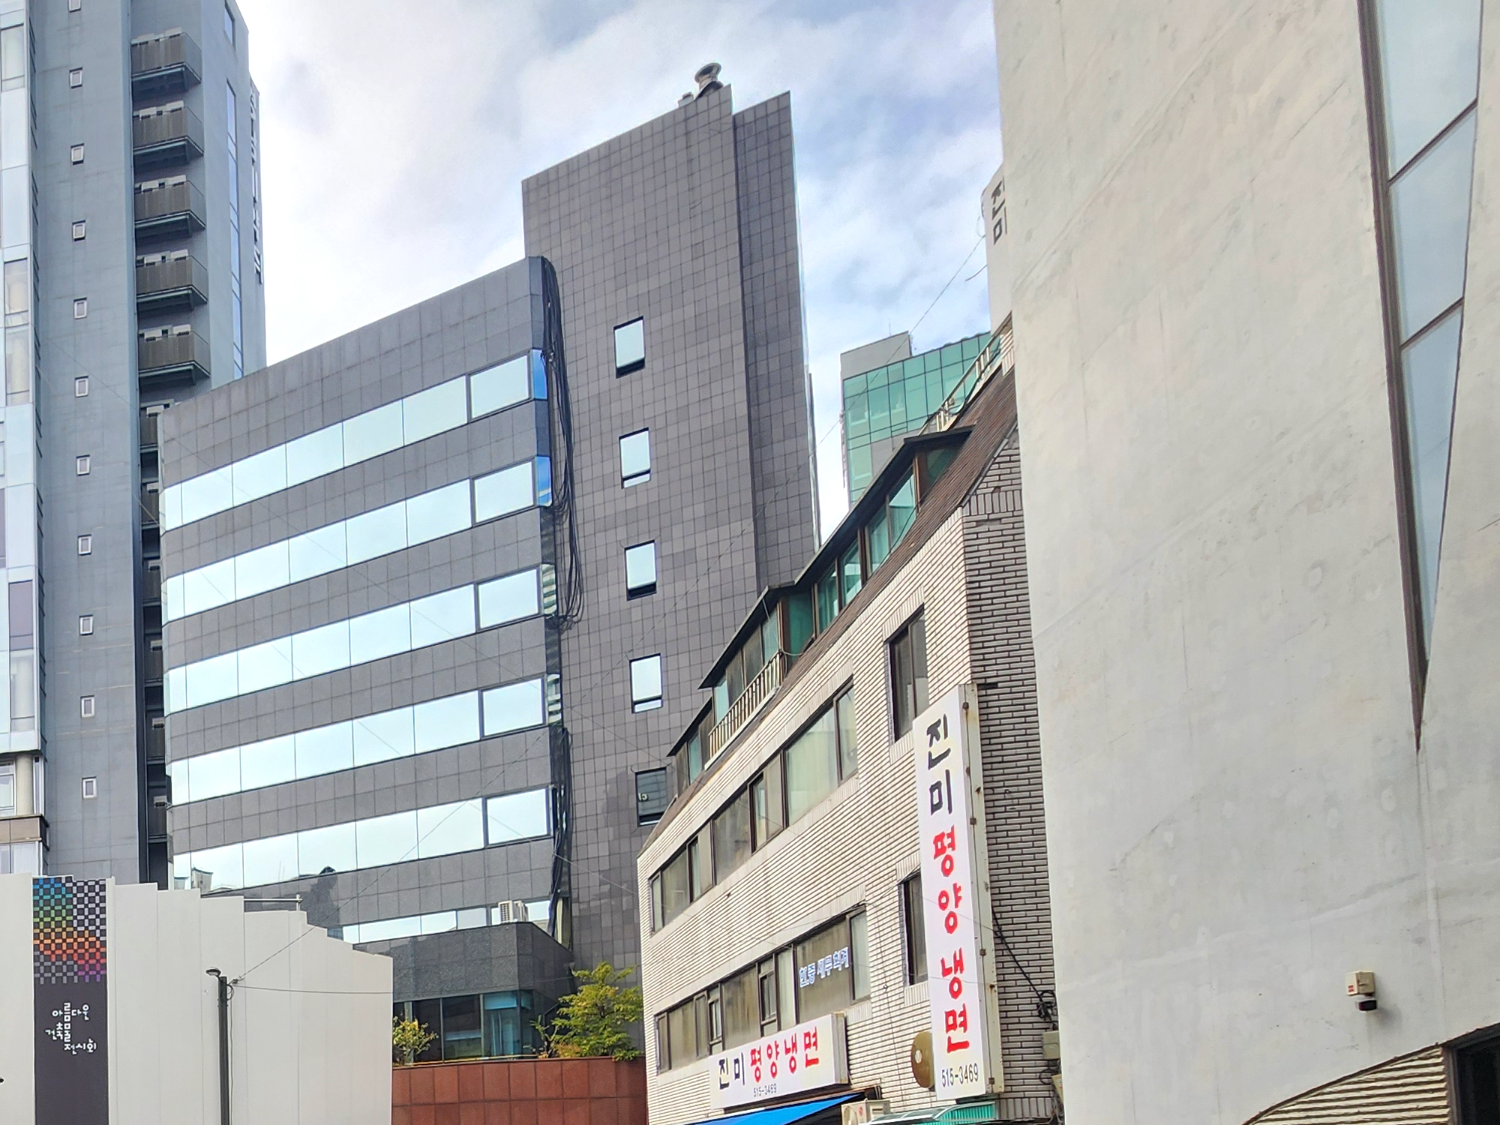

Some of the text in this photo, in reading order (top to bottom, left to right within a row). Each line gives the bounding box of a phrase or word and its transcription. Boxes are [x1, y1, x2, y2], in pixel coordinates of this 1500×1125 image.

[927, 713, 970, 1053] 진미 평양냉면
[52, 1002, 90, 1022] 아름다운
[45, 1022, 71, 1042] 건축물
[64, 1038, 97, 1055] 전시회
[718, 1026, 819, 1090] 진미 평양냉면
[940, 1061, 979, 1088] 515-3469
